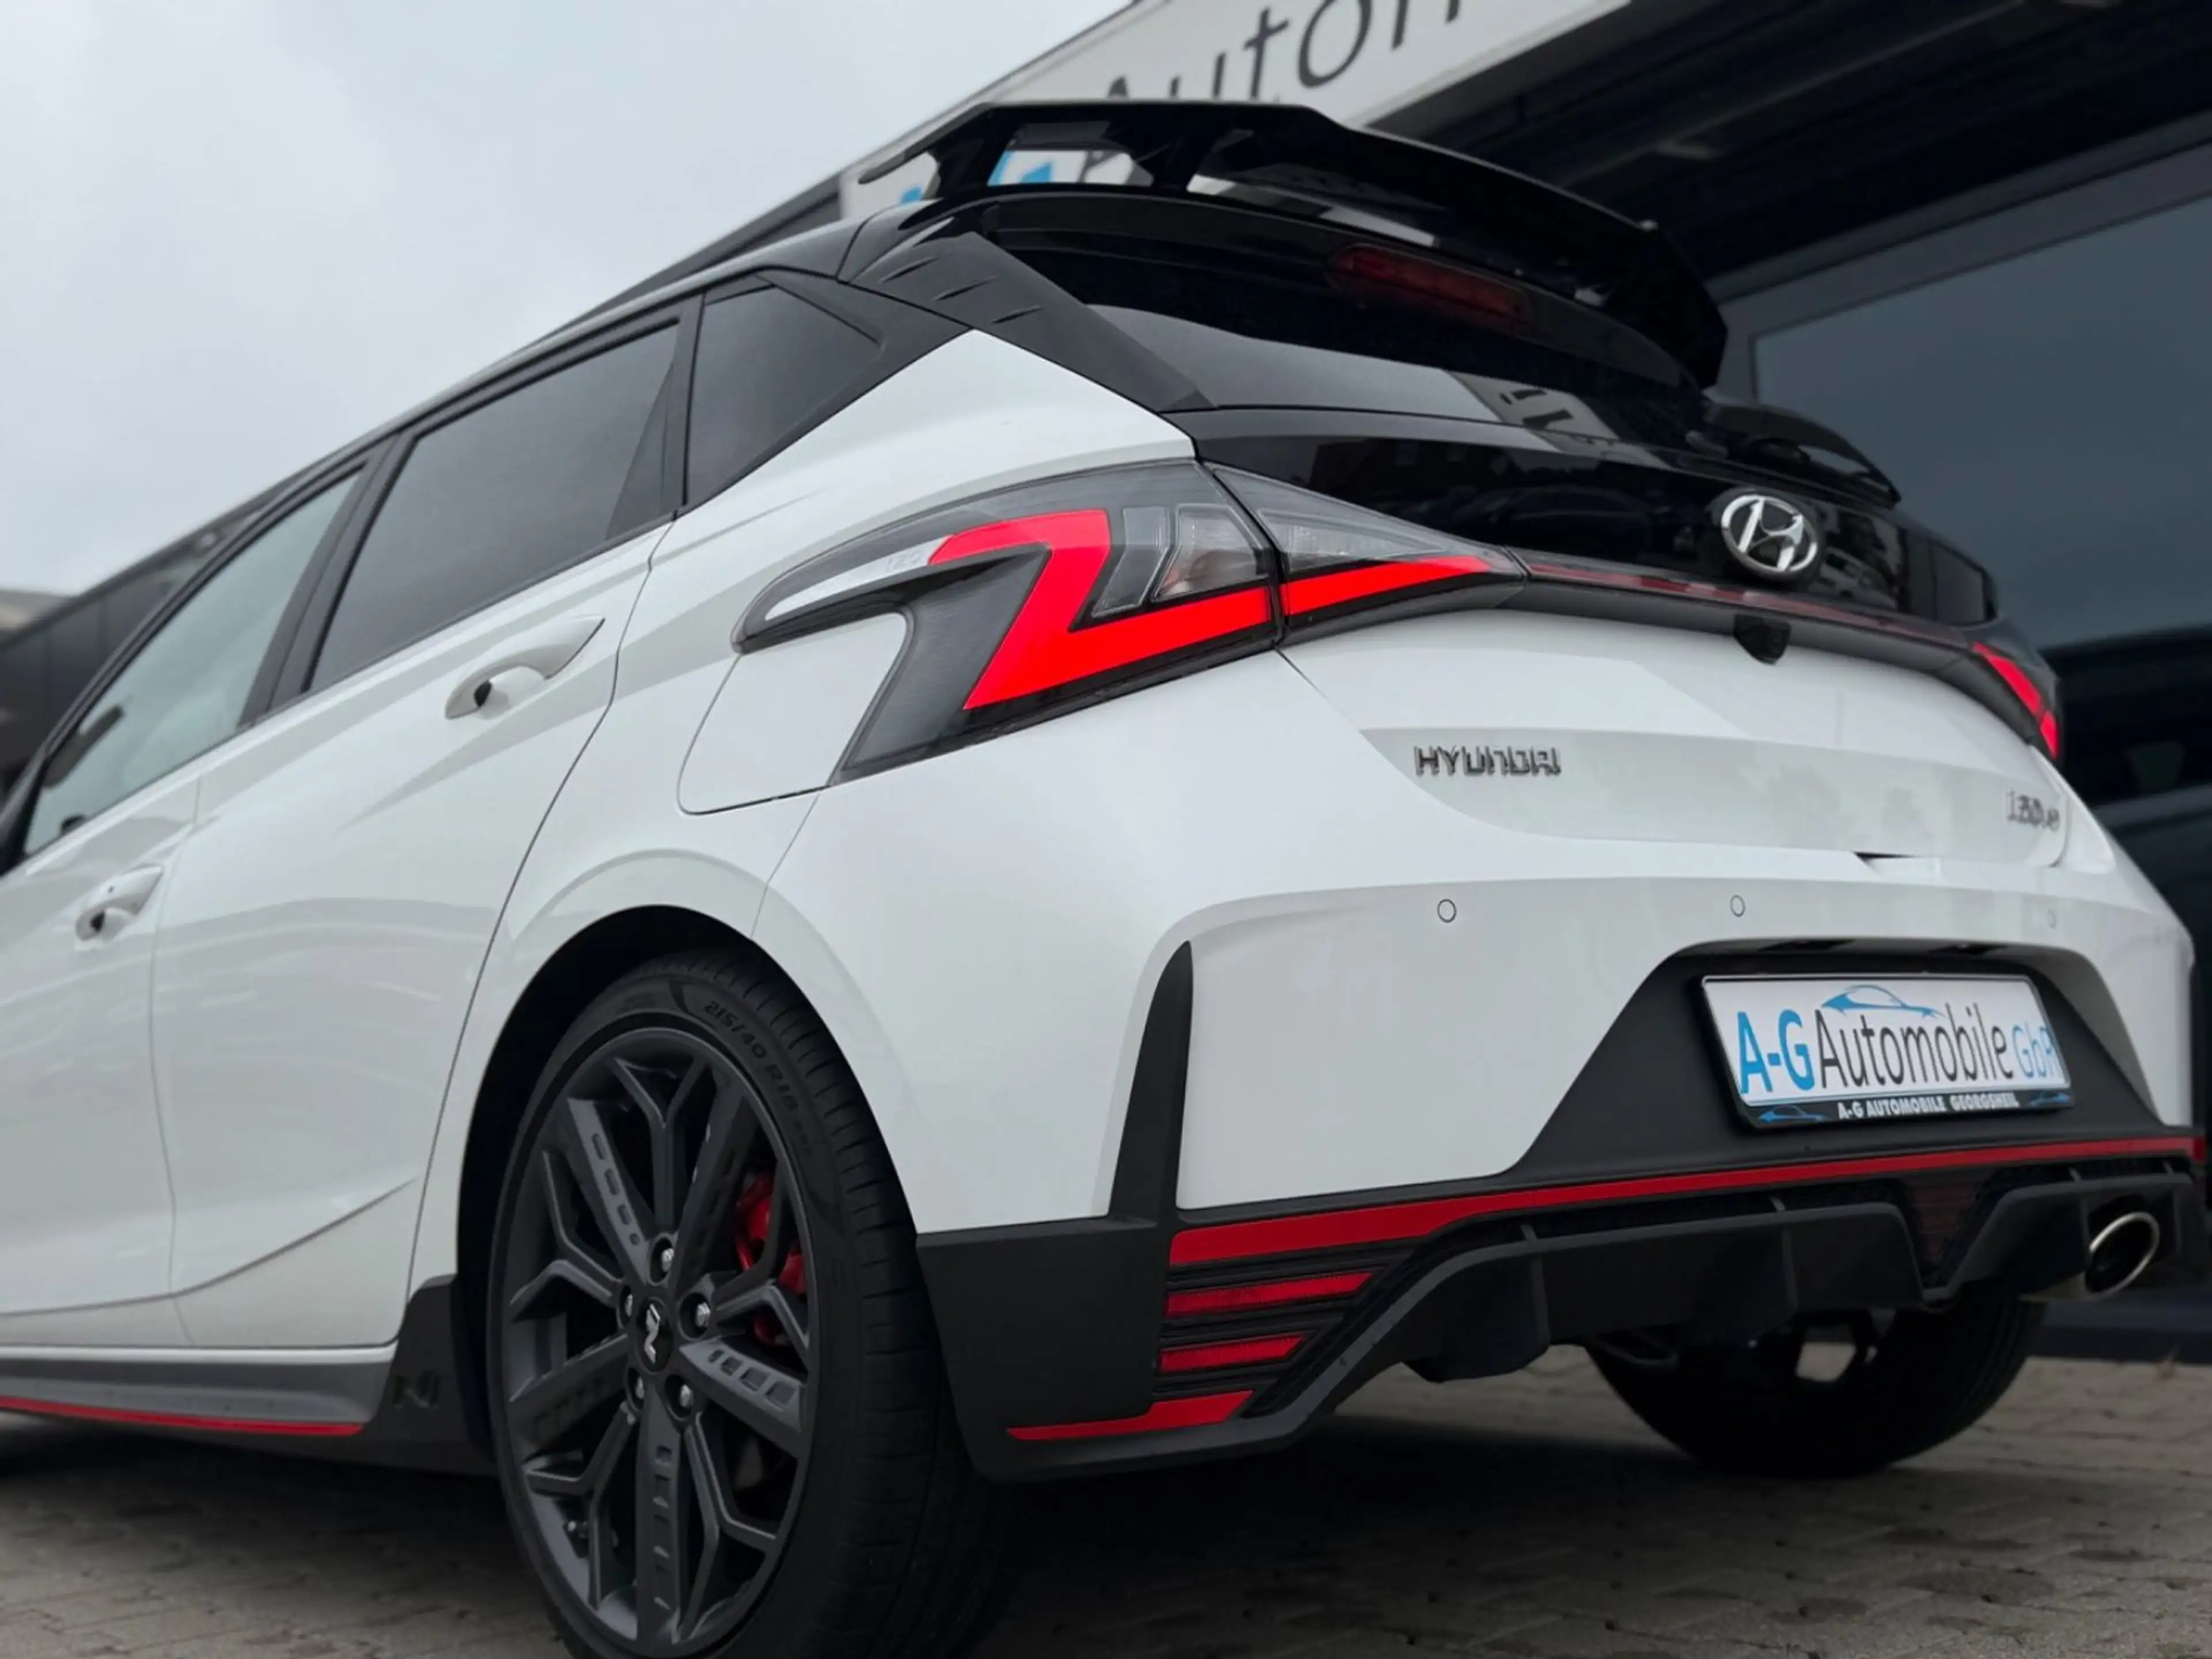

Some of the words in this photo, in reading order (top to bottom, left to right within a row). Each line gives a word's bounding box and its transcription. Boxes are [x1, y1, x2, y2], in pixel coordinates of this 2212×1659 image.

[1414, 745, 1562, 777] HYUNDAI
[704, 1000, 768, 1059] 215/40
[1837, 1100, 1864, 1119] A-G
[1866, 1095, 1948, 1118] AUTOMOBILE
